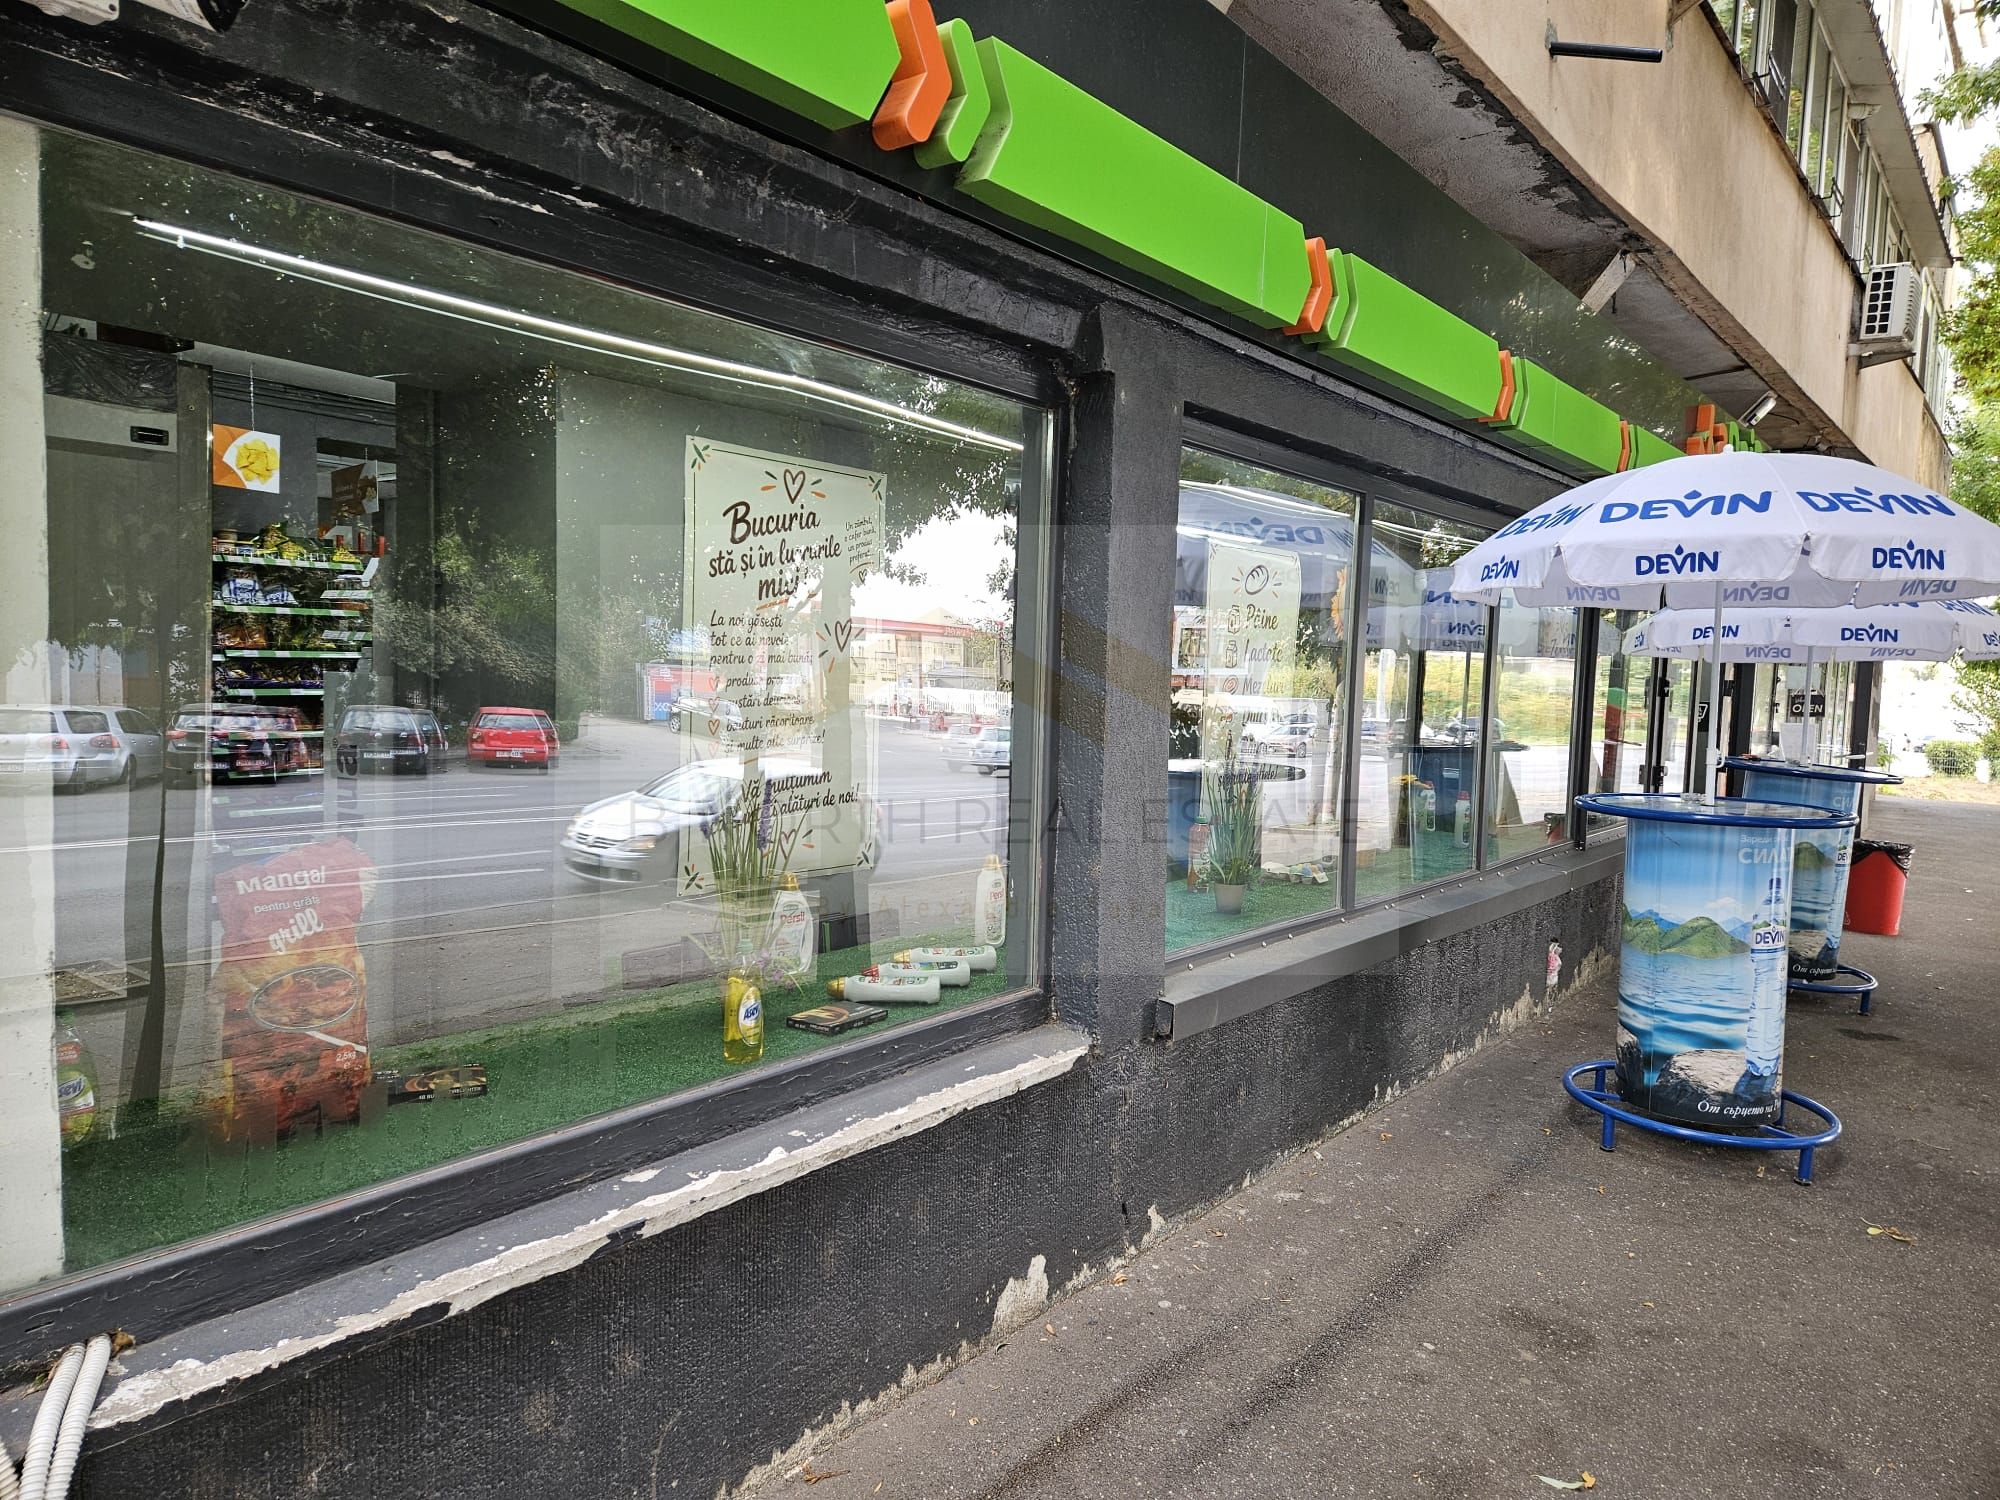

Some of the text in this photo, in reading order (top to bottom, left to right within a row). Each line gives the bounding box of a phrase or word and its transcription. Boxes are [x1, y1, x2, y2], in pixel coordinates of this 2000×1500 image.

[1600, 490, 1772, 523] DEVIN
[1796, 486, 1956, 516] DEVIN
[722, 501, 821, 544] Bucuria
[1495, 503, 1595, 539] DEVIN
[708, 534, 842, 578] stă și în lururile
[1480, 555, 1520, 582] DEVIN
[1635, 544, 1719, 576] DEVIN
[1872, 540, 1945, 570] DEVIN
[710, 609, 725, 627] La
[728, 614, 745, 627] noi
[1692, 624, 1740, 640] DEIN
[1840, 622, 1898, 643] DEVIN
[710, 631, 727, 647] tot
[730, 636, 742, 646] ce
[745, 633, 756, 646] ai
[709, 651, 745, 671] pentru
[747, 655, 754, 665] o
[767, 651, 786, 664] mai
[1792, 703, 1823, 713] OEN
[780, 783, 860, 816] alături de noi!
[236, 866, 326, 895] Mangal
[254, 901, 290, 914] pentru
[269, 908, 324, 954] grill
[1698, 1098, 1720, 1114] От
